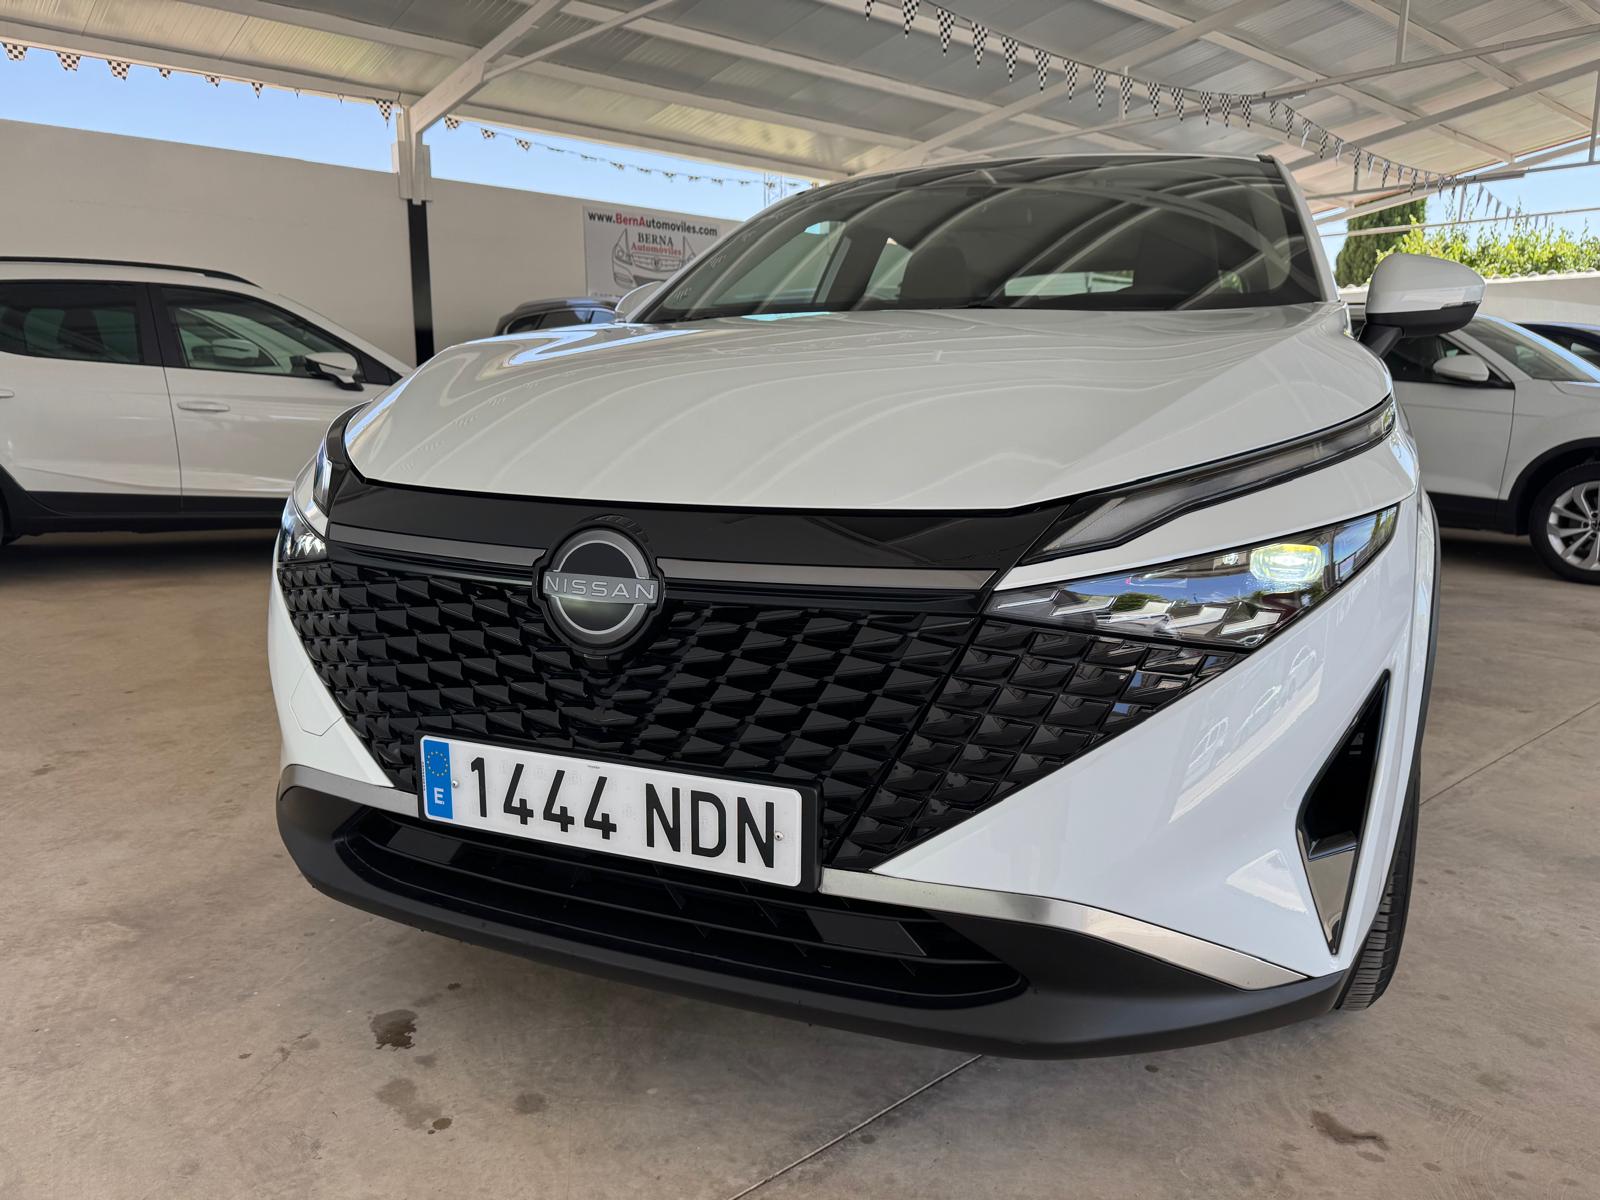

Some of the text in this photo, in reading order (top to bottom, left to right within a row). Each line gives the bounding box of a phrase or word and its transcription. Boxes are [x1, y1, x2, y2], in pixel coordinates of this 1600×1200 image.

[588, 211, 718, 236] www.BernAutomoviles.com
[638, 232, 674, 246] BERNA
[545, 575, 655, 600] NISSAN
[434, 787, 445, 805] E
[470, 756, 775, 869] 1444 NDN
